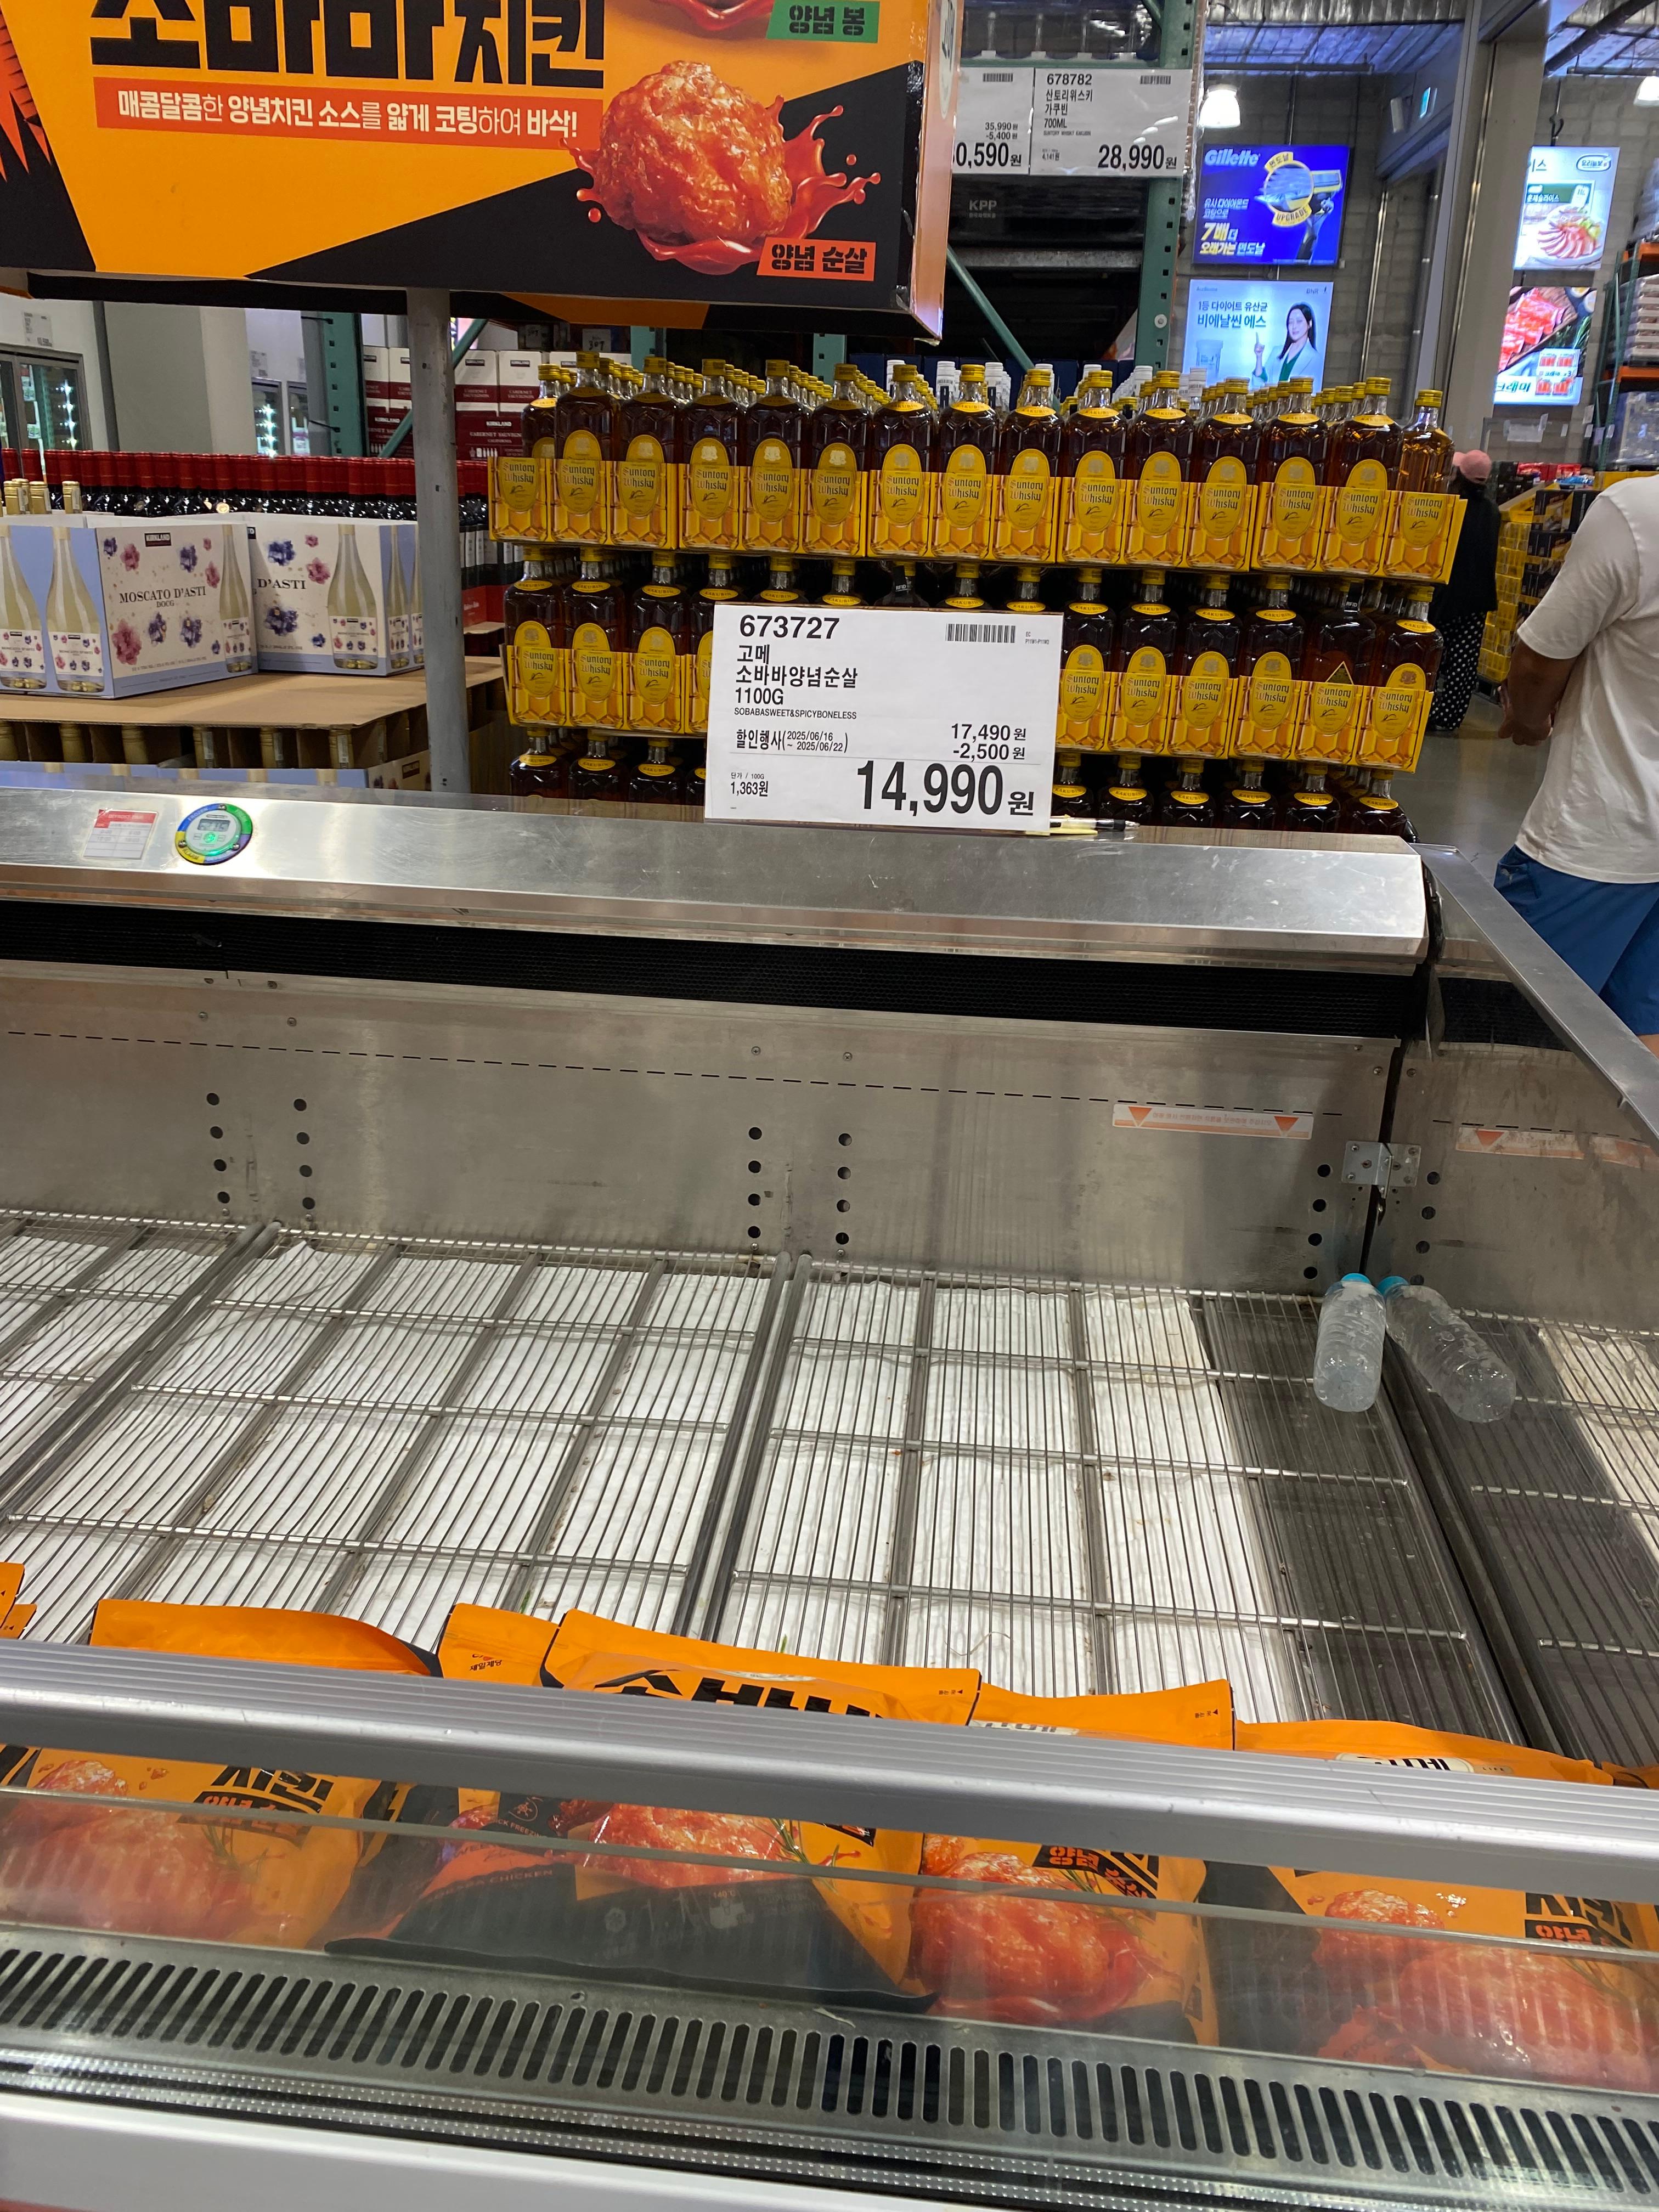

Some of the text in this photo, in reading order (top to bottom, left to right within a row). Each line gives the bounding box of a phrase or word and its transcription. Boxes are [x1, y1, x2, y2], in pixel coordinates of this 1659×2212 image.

[789, 4, 865, 36] 양념 봉
[1047, 74, 1092, 86] 678782
[1046, 89, 1093, 101] 산토리위스키
[117, 90, 577, 138] 매콤달콤한 양념치킨 소스를 얇게 코팅하여 바삭!
[1045, 104, 1068, 116] 가쿠빈
[1044, 117, 1067, 128] 700ML
[952, 142, 1022, 169] 0,590원
[1205, 149, 1260, 167] Gillette
[969, 200, 997, 211] KPP
[1277, 207, 1308, 221] UPGRADE
[771, 243, 867, 274] 양념 순살
[1211, 301, 1242, 312] 다이어트
[1244, 302, 1268, 312] 유산균
[1198, 313, 1266, 329] 비에날씬 에스
[503, 461, 535, 474] Suntory
[562, 463, 595, 476] Suntory
[623, 466, 655, 479] Suntory
[505, 473, 534, 485] Whisky
[564, 475, 594, 488] Whisky
[697, 469, 729, 482] Suntory
[757, 471, 789, 484] Suntory
[816, 475, 850, 487] Suntory
[887, 475, 919, 487] Suntory
[624, 477, 654, 489] Whisky
[697, 480, 727, 493] Whisky
[757, 482, 788, 494] Whisky
[948, 477, 981, 489] Suntory
[1010, 479, 1043, 492] Suntory
[1081, 482, 1114, 494] Suntory
[818, 485, 849, 497] Whisky
[887, 486, 917, 498] Whisky
[948, 488, 979, 500] Whisky
[1010, 490, 1041, 502] Whisky
[1142, 484, 1177, 498] Suntory
[1206, 487, 1241, 500] Suntory
[1279, 487, 1314, 500] Suntory
[1081, 493, 1112, 505] Whisky
[1144, 495, 1175, 508] Whisky
[1207, 498, 1238, 510] Whisky
[1344, 492, 1378, 505] Suntory
[1408, 495, 1443, 509] Suntory
[1279, 499, 1311, 511] Whisky
[1344, 503, 1375, 516] Whisky
[1408, 506, 1438, 520] Whisky
[257, 578, 306, 590] D'ASTI
[119, 586, 206, 603] MOSCATO D'ASTI
[740, 615, 840, 639] 673727
[522, 651, 554, 662] Suntory
[580, 653, 612, 665] Suntory
[737, 644, 770, 664] 고메
[524, 661, 553, 672] Whisky
[638, 657, 669, 669] Suntory
[581, 664, 610, 676] Whisky
[639, 667, 669, 679] Whisky
[736, 665, 858, 689] 소바바양념순살
[1066, 674, 1099, 685] Suntory
[1127, 676, 1160, 689] Suntory
[1066, 683, 1097, 696] Whisky
[1188, 681, 1221, 691] Suntory
[1255, 681, 1290, 694] Suntory
[735, 688, 784, 706] 1100G
[1127, 687, 1158, 699] Whisky
[1188, 690, 1218, 702] Whisky
[1255, 691, 1286, 704] Whisky
[1317, 687, 1351, 698] Suntory
[1379, 691, 1413, 703] Suntory
[1317, 696, 1348, 709] Whisky
[1379, 701, 1409, 714] Whisky
[734, 707, 857, 719] SOBABASWEET&SPICYBONELESS
[730, 781, 769, 797] 1,363원
[470, 1660, 503, 1671] 제일제당
